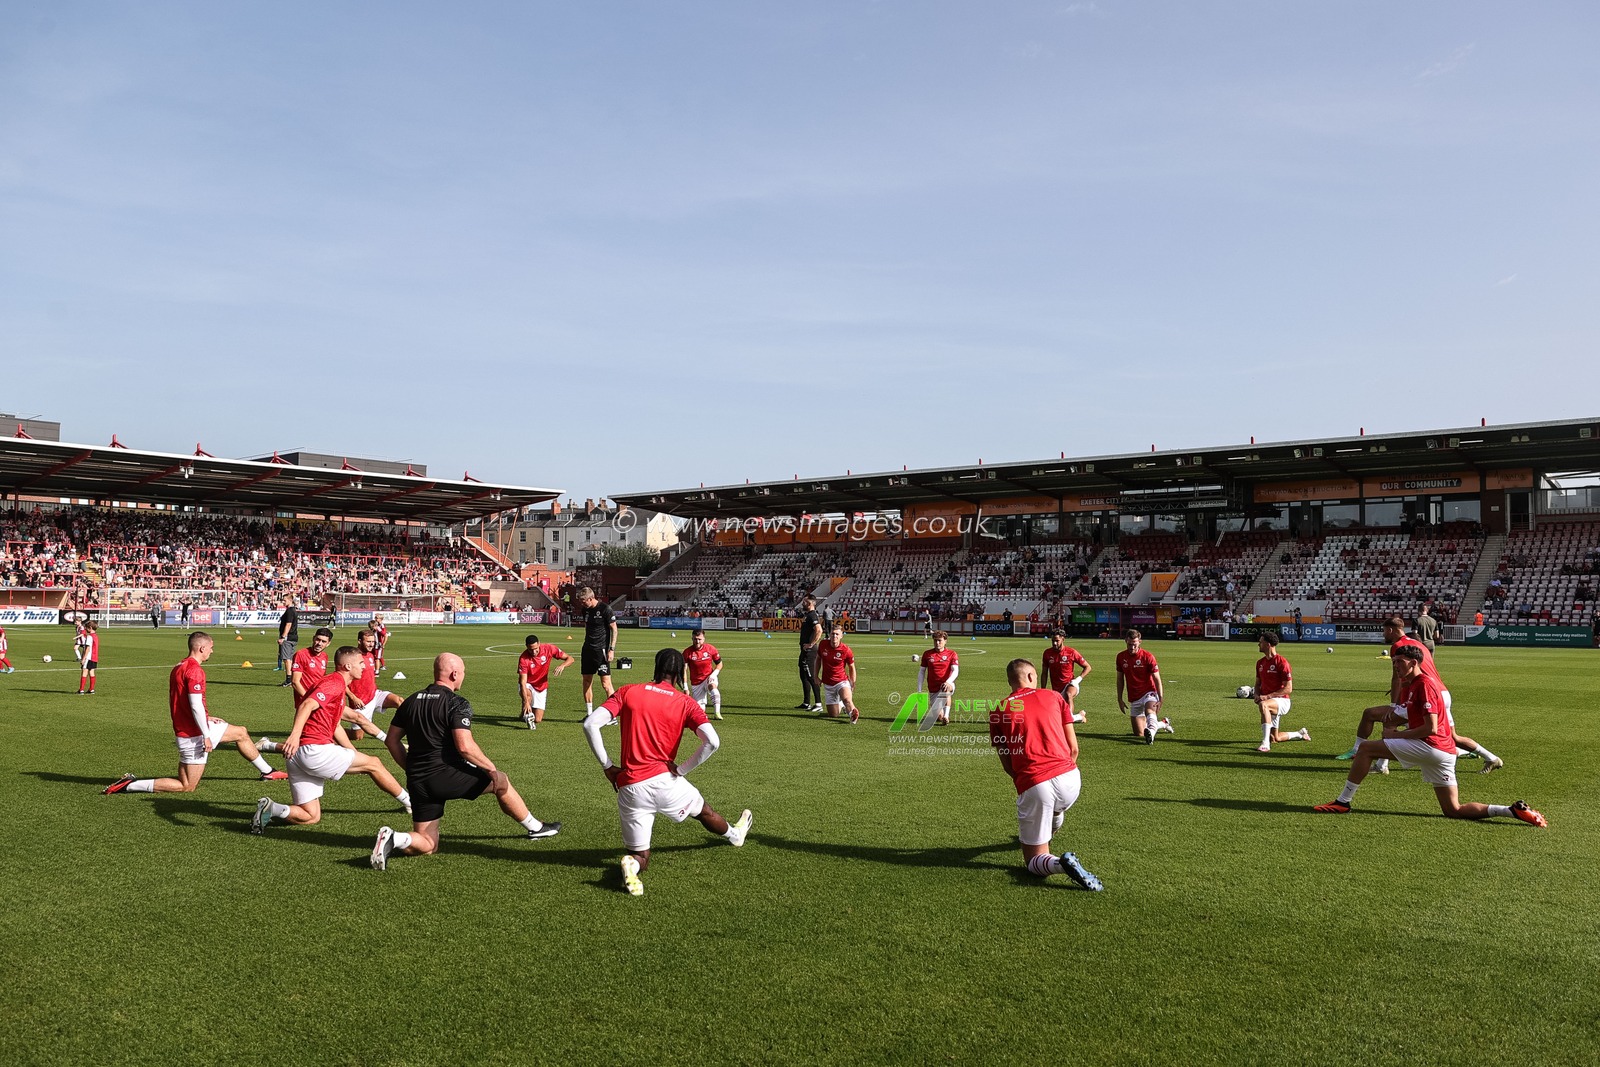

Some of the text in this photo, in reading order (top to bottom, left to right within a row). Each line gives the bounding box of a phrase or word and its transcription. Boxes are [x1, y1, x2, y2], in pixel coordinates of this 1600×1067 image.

[1382, 478, 1458, 490] OUR COMMUNITY
[1080, 498, 1104, 506] EXETER
[1180, 606, 1212, 616] GRP
[23, 611, 57, 622] Thrifty
[193, 612, 210, 621] bet
[223, 612, 251, 622] Thrifty
[520, 613, 542, 622] Sands
[770, 619, 790, 630] APPLE
[975, 623, 1011, 631] EX2GROUP
[1281, 625, 1334, 635] Raio Exe
